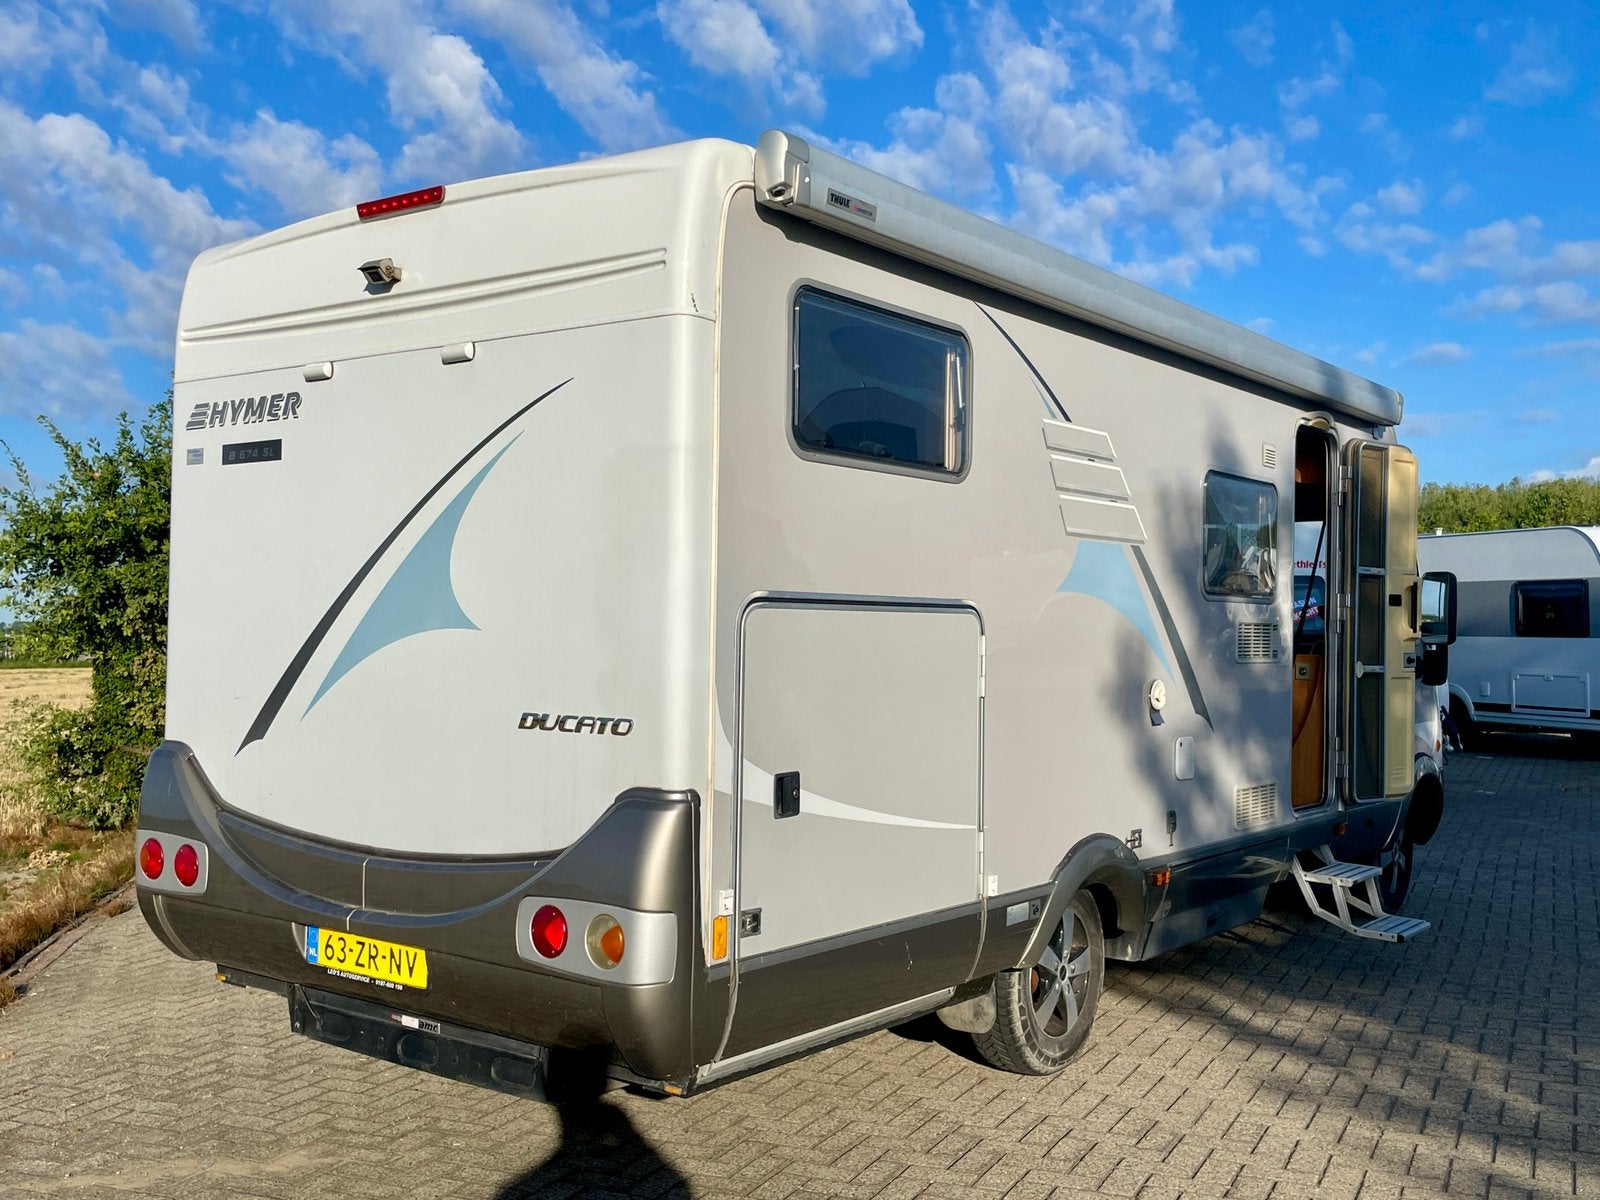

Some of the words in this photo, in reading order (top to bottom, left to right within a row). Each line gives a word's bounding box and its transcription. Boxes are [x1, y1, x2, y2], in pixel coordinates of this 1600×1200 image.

[830, 193, 850, 208] THULE
[209, 391, 302, 428] HYMER
[239, 449, 259, 460] 674
[518, 712, 634, 736] DUCATO
[309, 947, 318, 957] NL
[325, 935, 418, 978] 63-ZR-NV
[419, 1021, 438, 1032] amc
